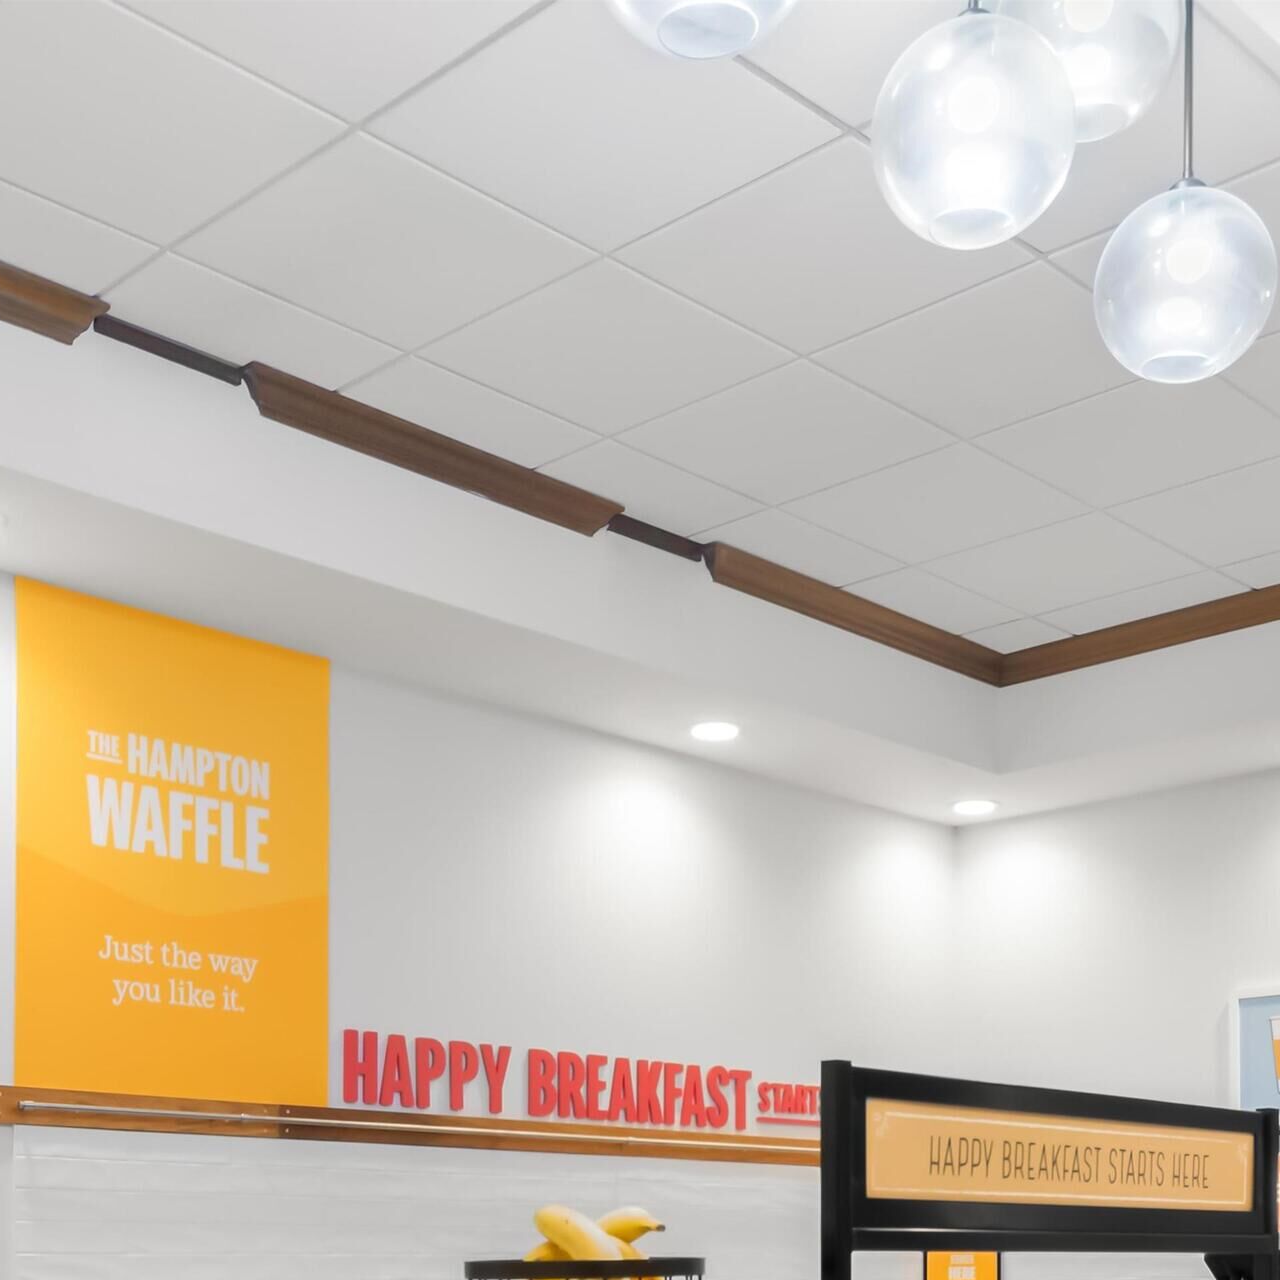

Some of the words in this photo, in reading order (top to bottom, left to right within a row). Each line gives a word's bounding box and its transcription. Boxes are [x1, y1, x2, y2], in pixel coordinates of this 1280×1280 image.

[87, 730, 121, 758] THE
[127, 732, 271, 801] HAMPTON
[86, 773, 271, 875] WAFFLE
[98, 934, 154, 966] Just
[160, 940, 202, 971] the
[208, 953, 259, 983] way
[112, 978, 162, 1007] you
[168, 976, 216, 1009] like
[222, 984, 246, 1013] it.
[342, 1029, 513, 1114] HAPPY
[528, 1048, 753, 1131] BREAKFAST
[757, 1082, 820, 1115] START
[929, 1135, 994, 1178] HAPPY
[1001, 1140, 1102, 1184] BREAKFAST
[1108, 1148, 1166, 1188] STARTS
[1171, 1152, 1210, 1189] HERE
